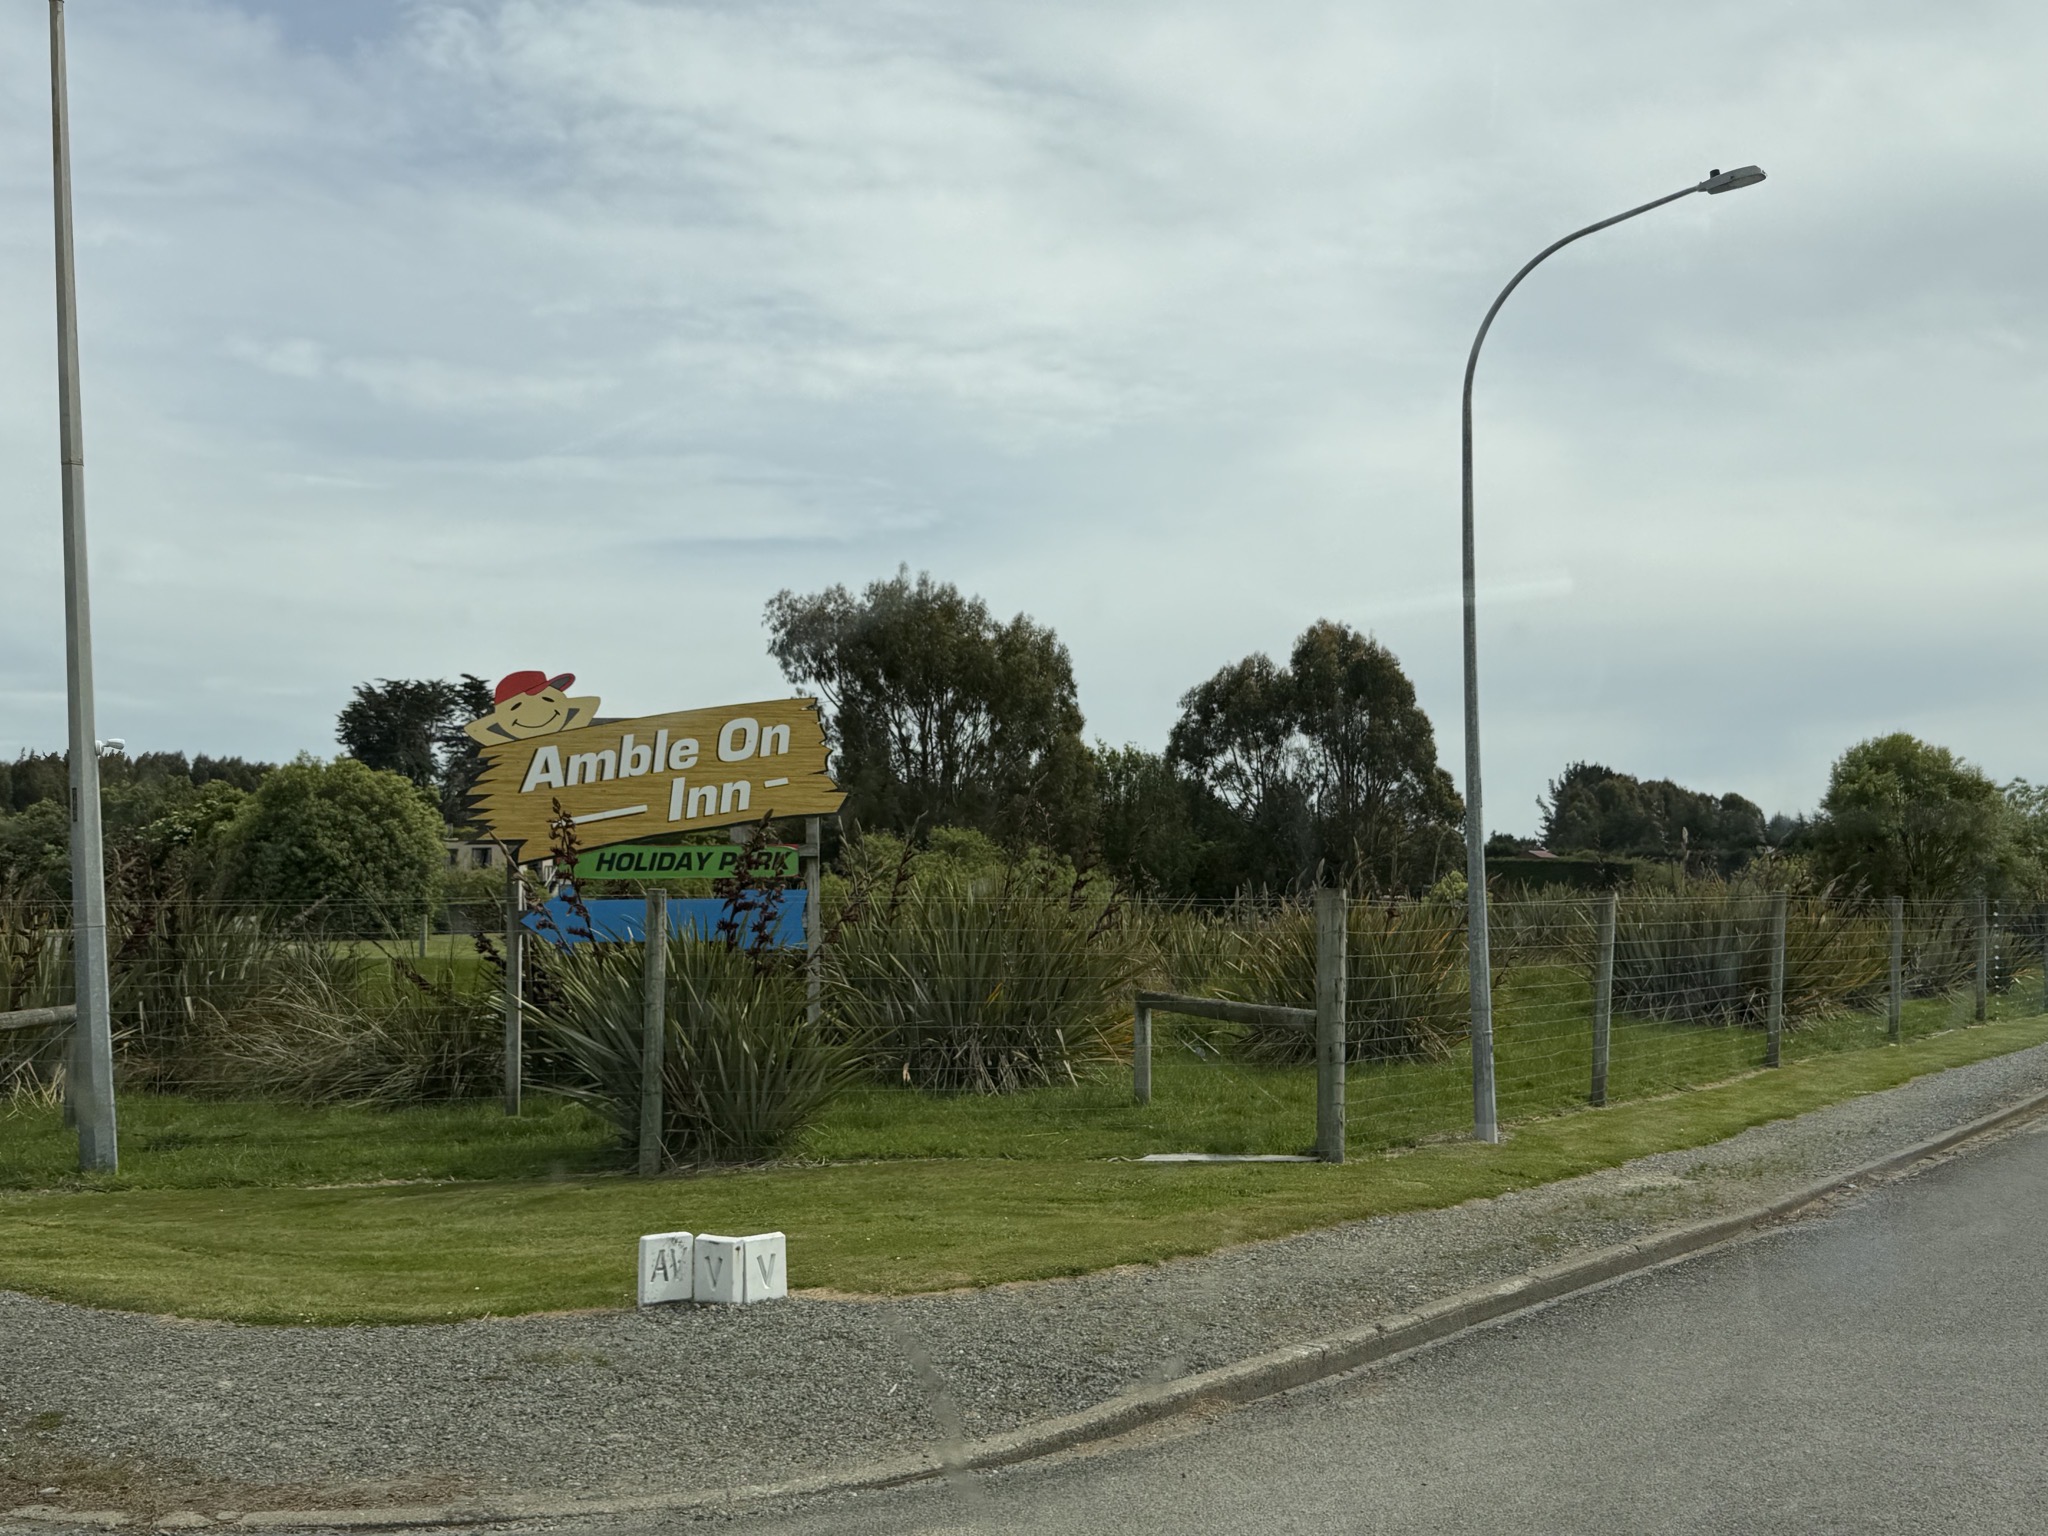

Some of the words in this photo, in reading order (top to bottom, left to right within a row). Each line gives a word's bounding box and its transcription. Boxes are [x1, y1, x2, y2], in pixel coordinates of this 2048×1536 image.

[520, 728, 699, 793] Amble
[717, 717, 791, 763] On
[668, 776, 751, 822] Inn
[595, 852, 713, 872] HOLIDAY
[704, 1255, 723, 1291] V
[756, 1253, 776, 1289] V
